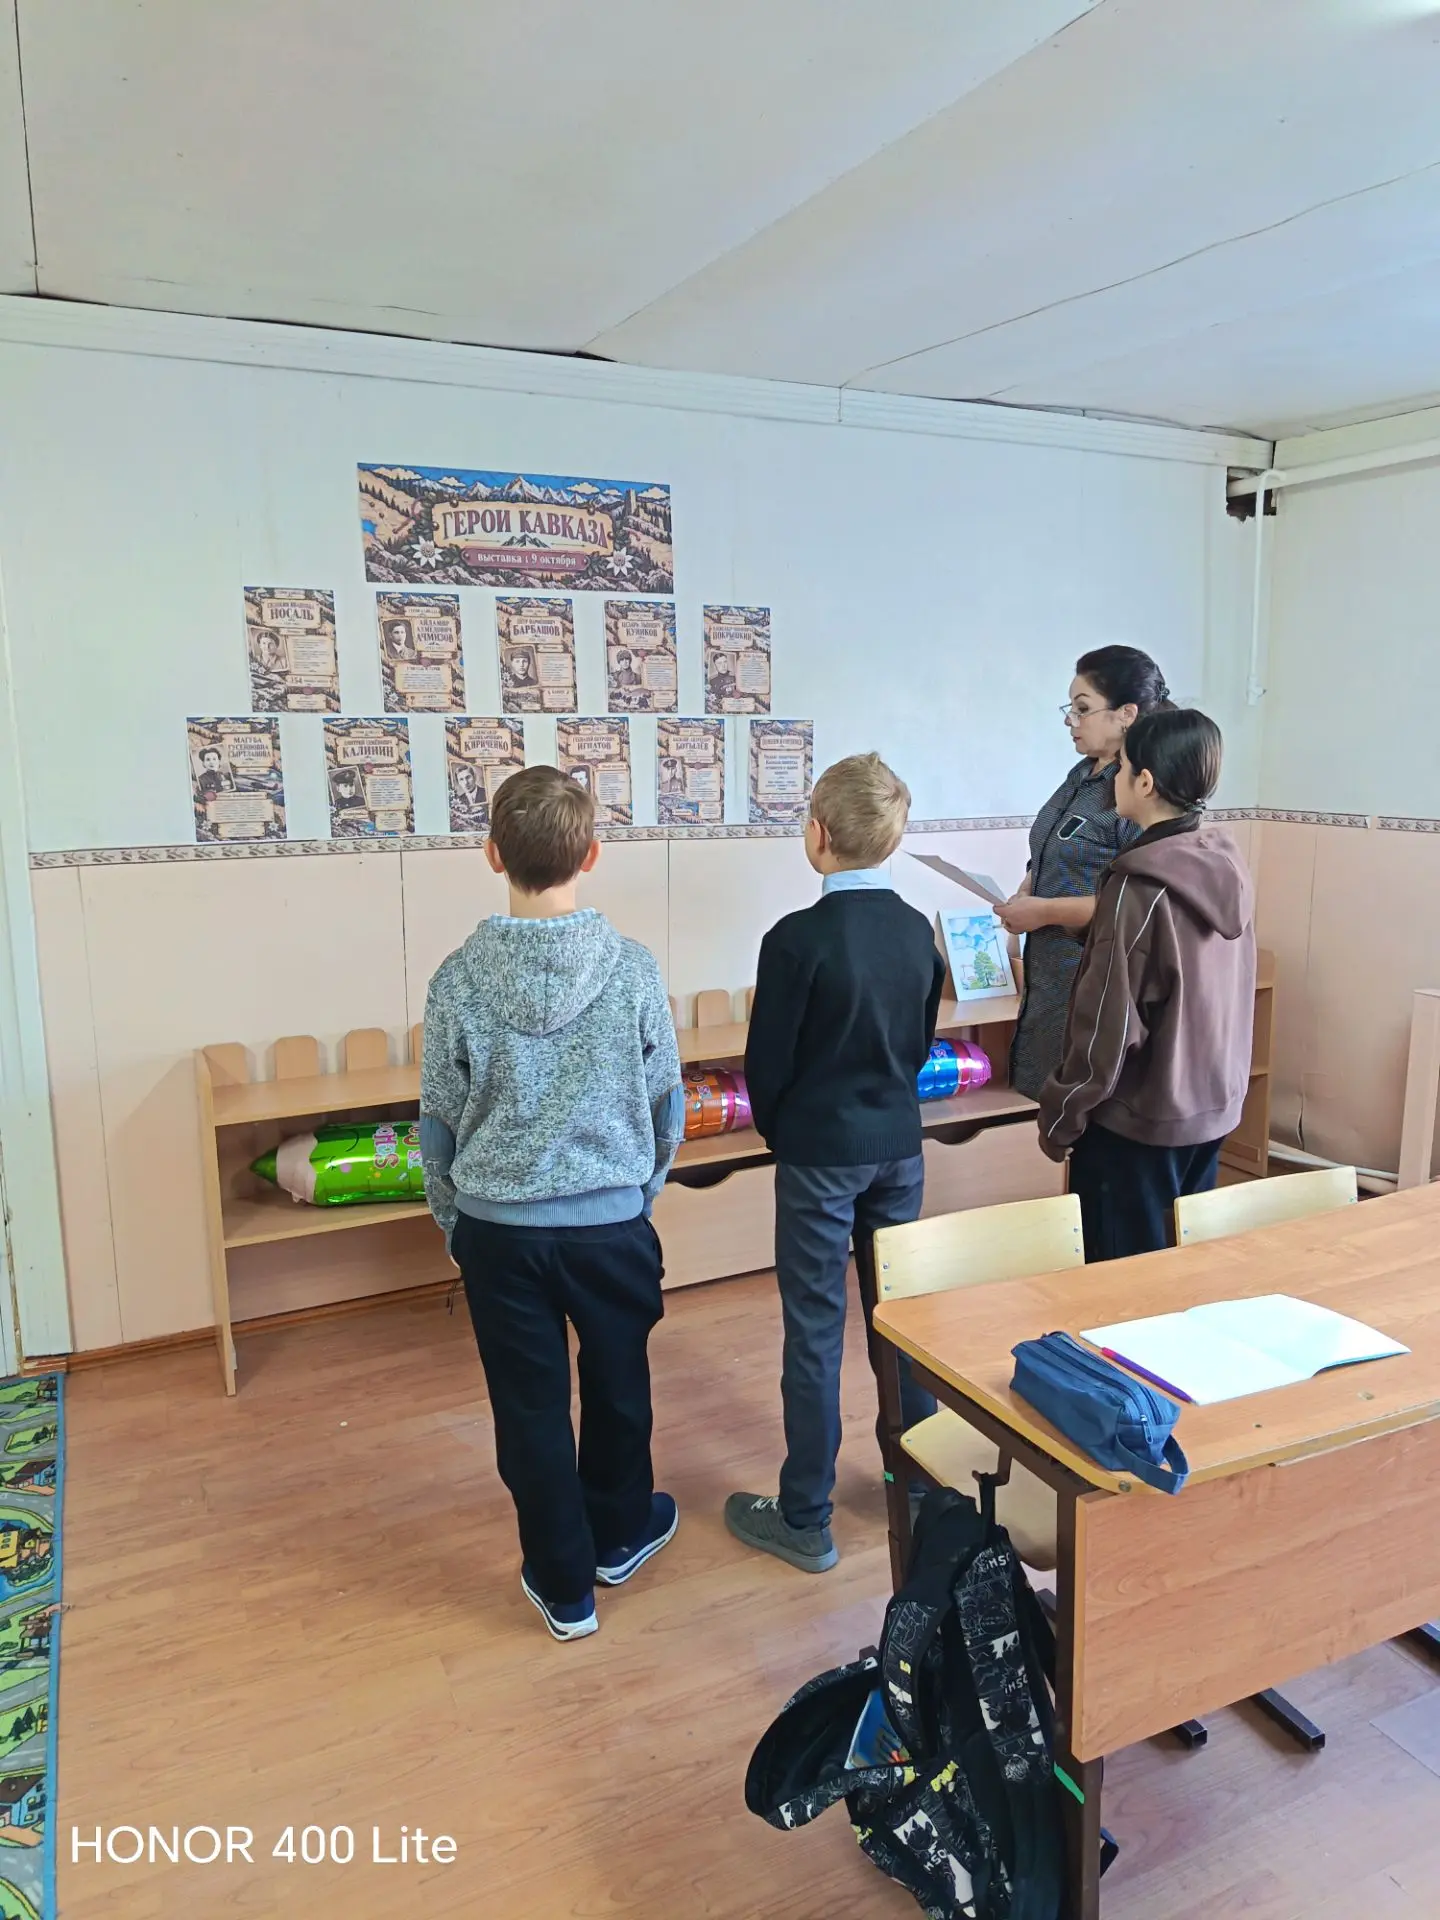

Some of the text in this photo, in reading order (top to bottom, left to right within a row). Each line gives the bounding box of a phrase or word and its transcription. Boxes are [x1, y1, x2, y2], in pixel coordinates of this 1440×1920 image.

[442, 508, 608, 549] ГЕРОИ КАВКАЗА
[477, 553, 576, 566] выставка 9 октября
[269, 608, 314, 620] НОСАЛЬ
[512, 624, 561, 636] БАРБАШОВ
[342, 745, 395, 758] КАЛИНИН
[464, 740, 509, 752] КИРИЧЕНКО
